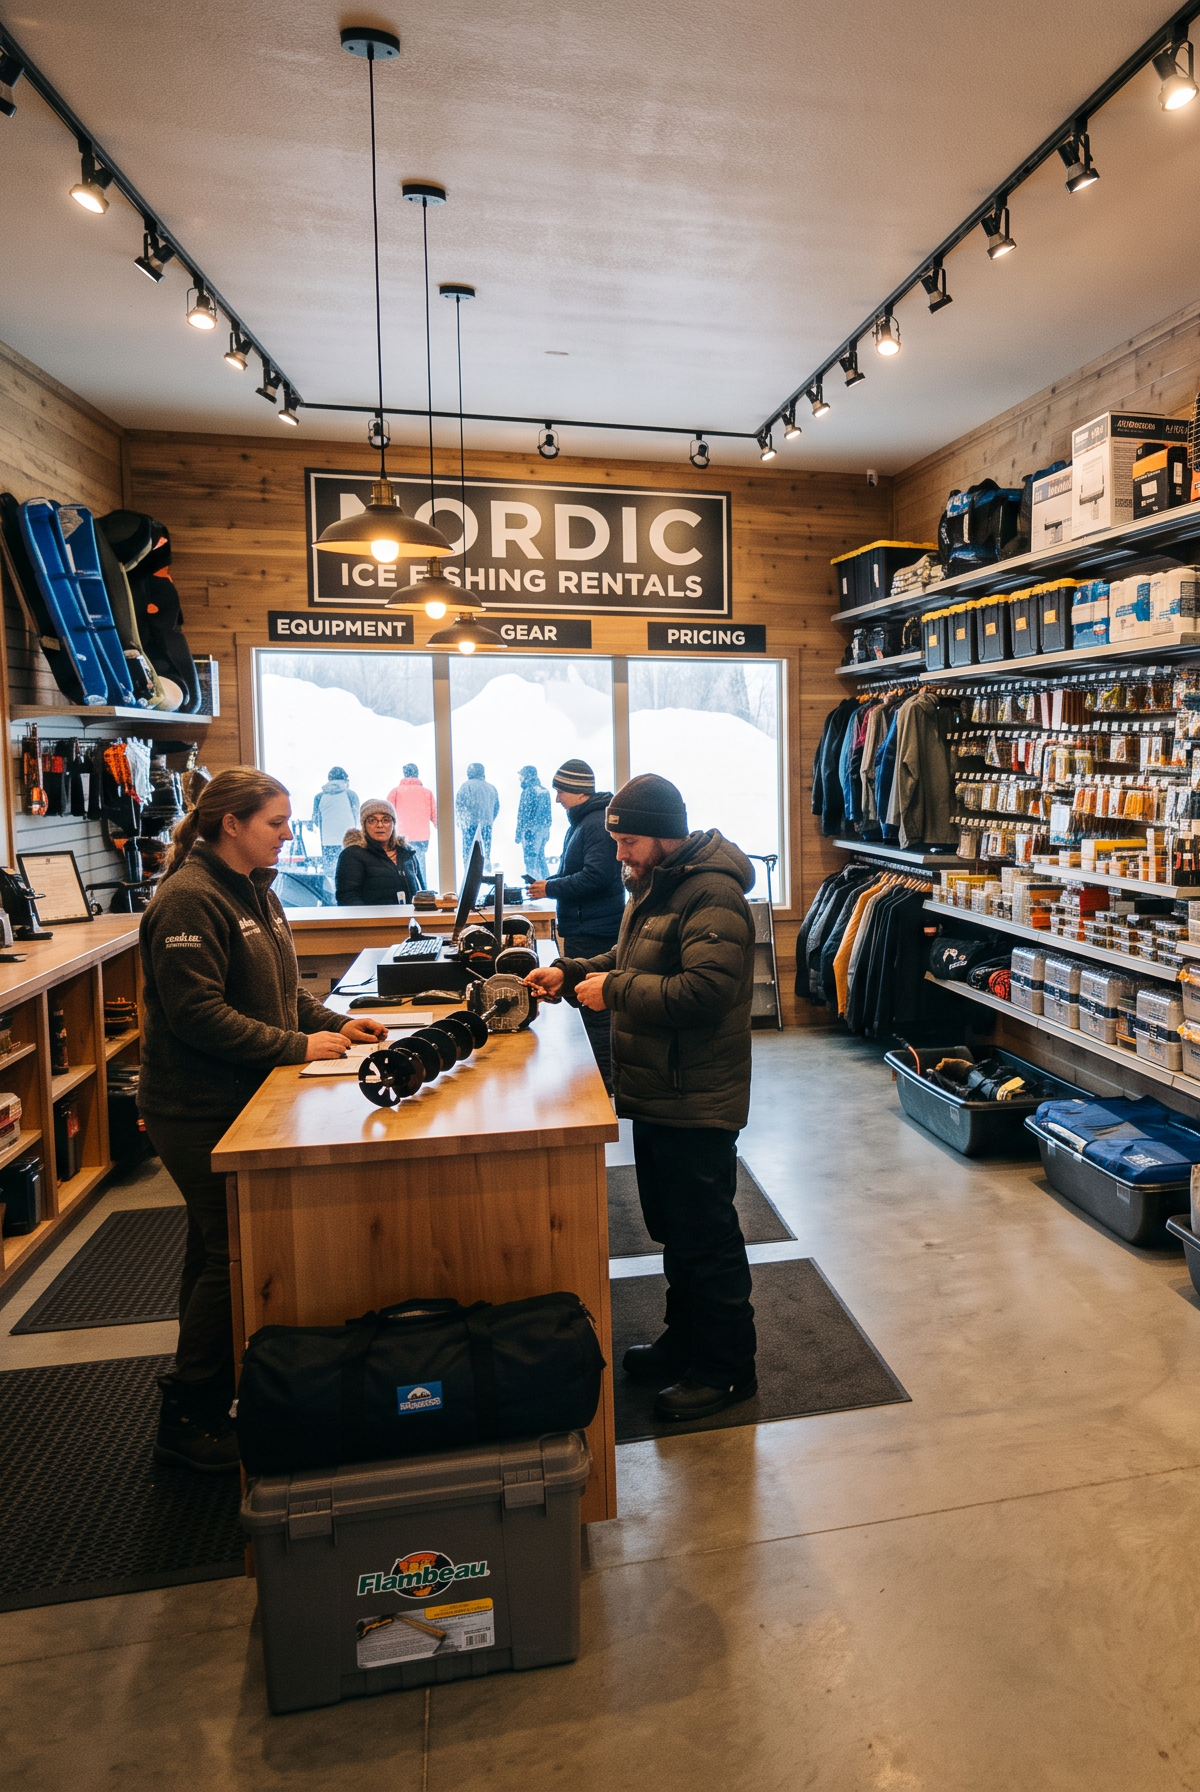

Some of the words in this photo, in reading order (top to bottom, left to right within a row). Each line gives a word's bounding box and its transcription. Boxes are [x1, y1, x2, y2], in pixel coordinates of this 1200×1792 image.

[341, 563, 397, 587] ICE
[410, 565, 546, 592] FSHING
[558, 570, 703, 598] RENTALS
[276, 618, 406, 639] EQUIPMENT
[500, 624, 557, 642] GEAR
[667, 628, 746, 646] PRICING
[357, 1561, 488, 1596] Flambeau
